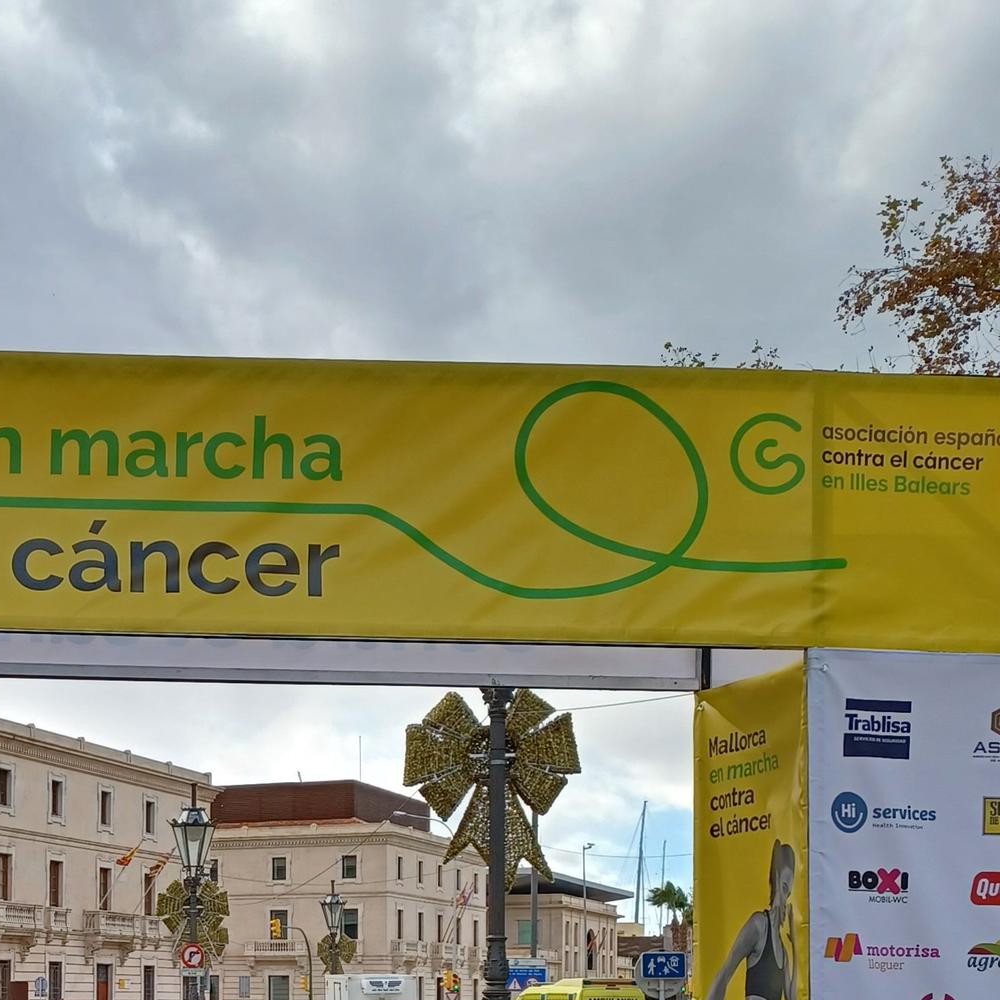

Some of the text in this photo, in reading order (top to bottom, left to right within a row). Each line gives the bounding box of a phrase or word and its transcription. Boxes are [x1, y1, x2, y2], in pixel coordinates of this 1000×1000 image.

[50, 415, 343, 480] marcha
[822, 424, 1000, 449] asociación españ
[822, 449, 983, 472] contra el cáncer
[822, 473, 970, 496] en Illes Balears
[12, 520, 340, 597] cáncer
[845, 713, 911, 734] Trablisa
[709, 729, 766, 758] Mallorca
[710, 754, 779, 784] en marcha
[710, 789, 754, 811] contra
[840, 804, 936, 821] Hi services
[710, 814, 771, 838] el cáncer
[848, 868, 909, 895] BOXI
[867, 945, 940, 958] motorisa
[868, 960, 904, 971] lloguer
